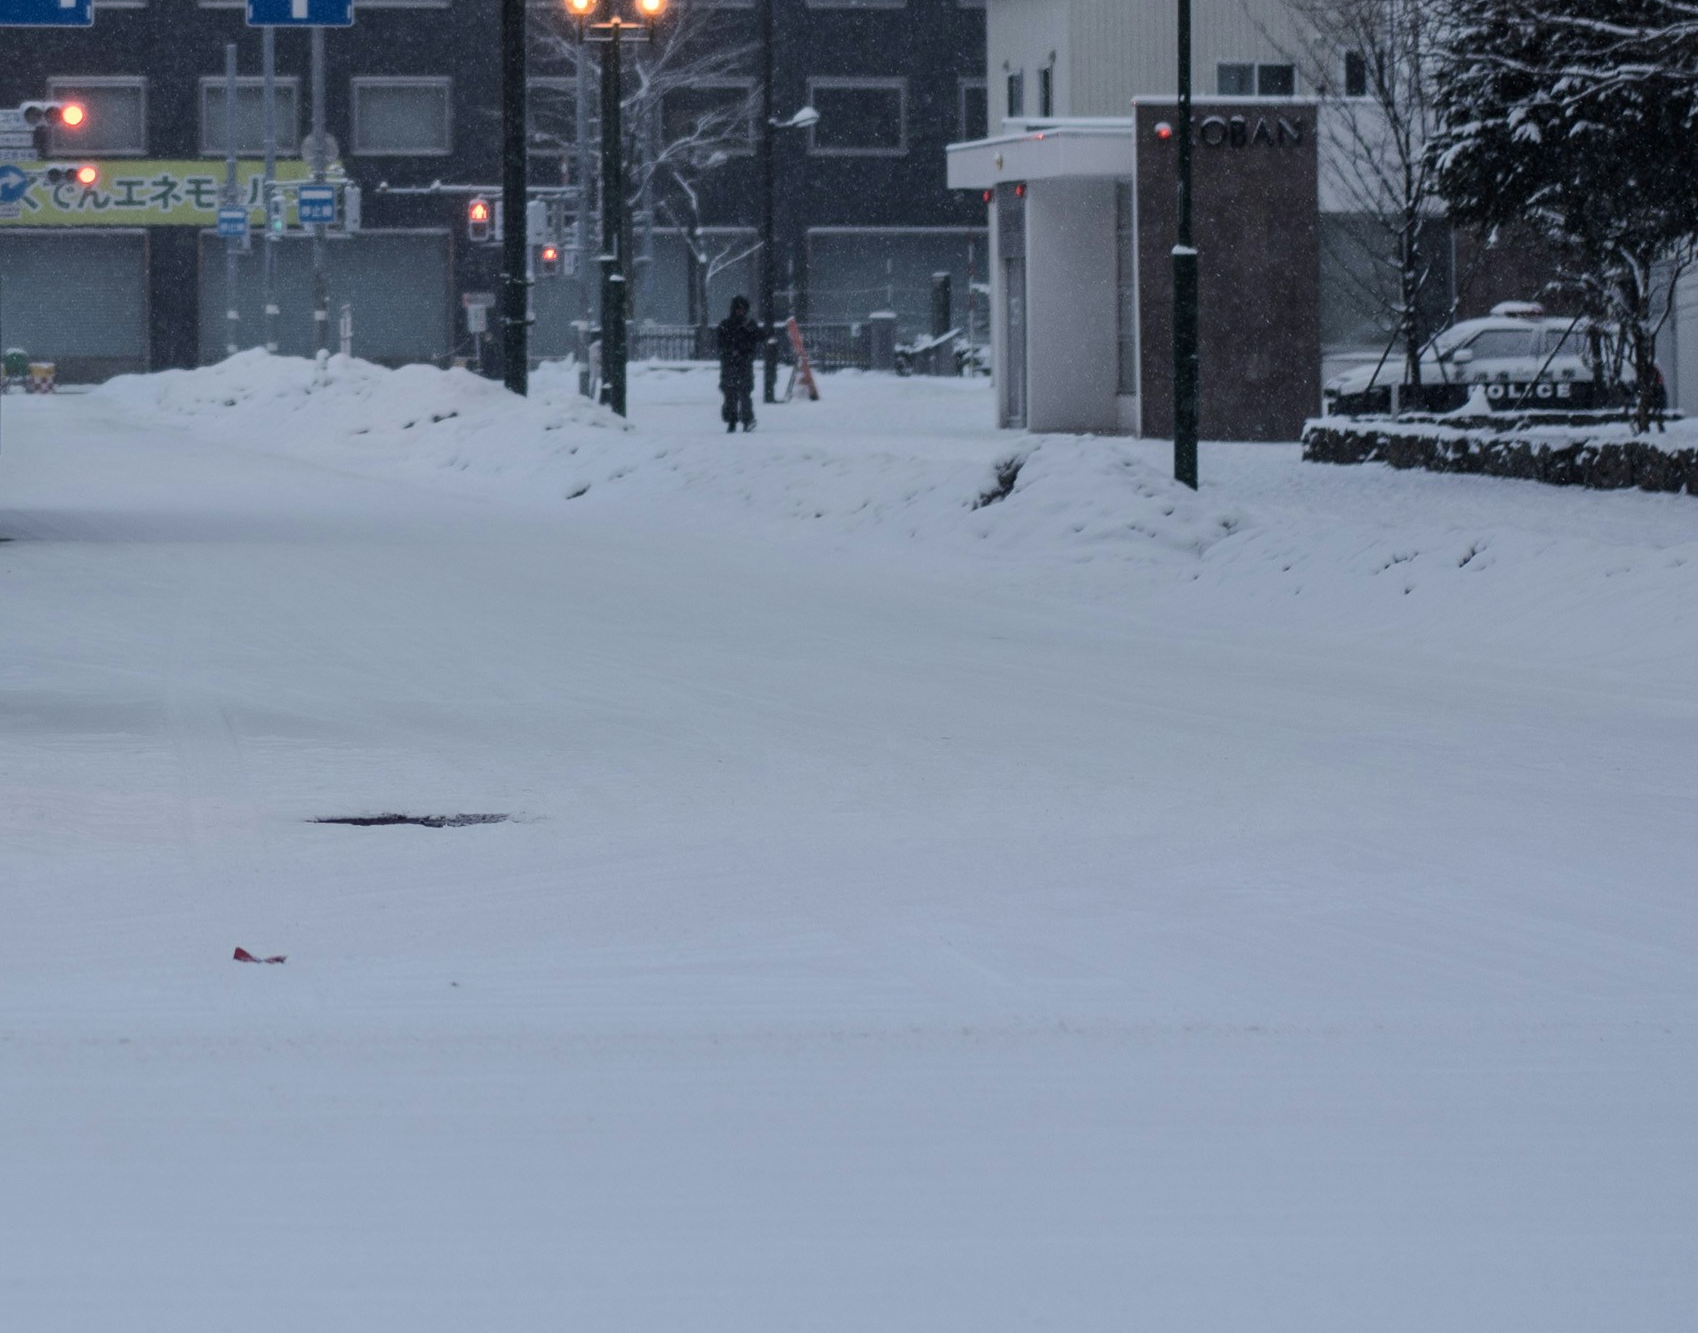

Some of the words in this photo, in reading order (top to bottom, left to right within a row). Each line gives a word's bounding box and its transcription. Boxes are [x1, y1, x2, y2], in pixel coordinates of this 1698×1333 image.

[1189, 116, 1303, 147] OBAN
[21, 176, 262, 209] くでんエネモ
